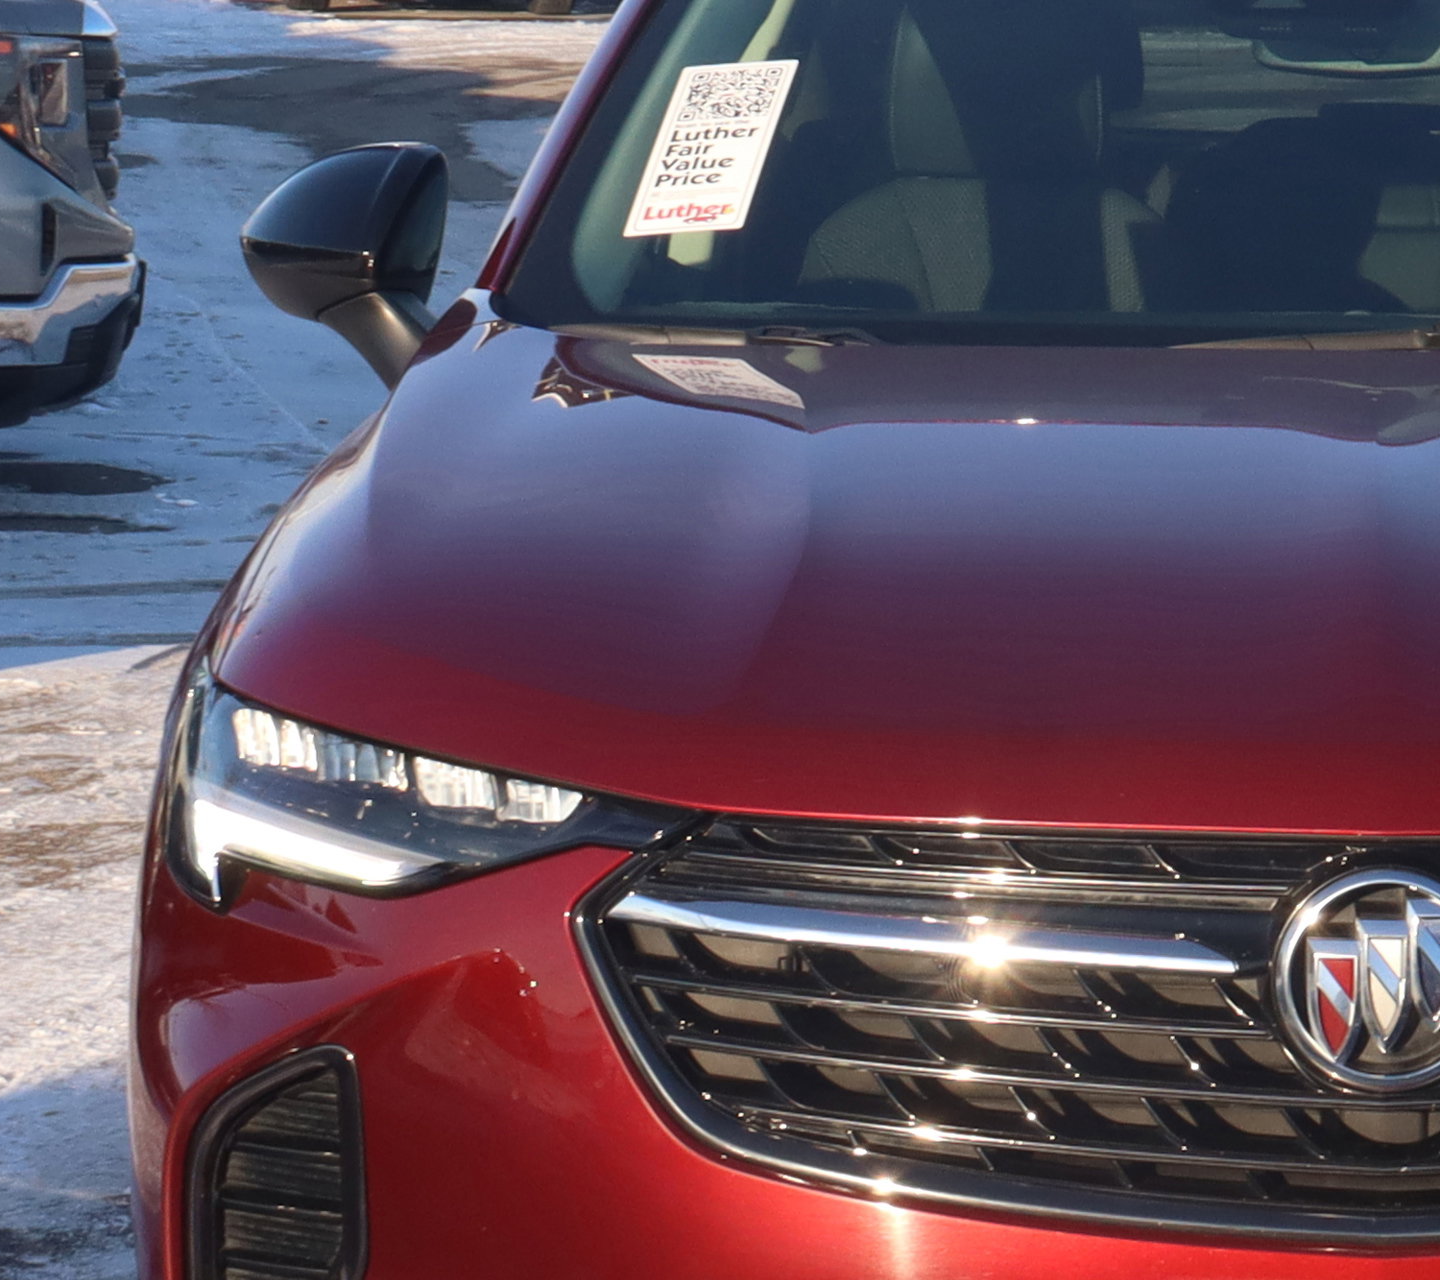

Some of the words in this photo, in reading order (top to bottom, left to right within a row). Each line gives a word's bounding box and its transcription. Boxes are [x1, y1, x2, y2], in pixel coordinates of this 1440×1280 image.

[671, 126, 760, 143] Luther
[665, 142, 715, 158] Fair
[662, 157, 735, 172] Value
[654, 171, 722, 187] Price
[643, 203, 732, 221] Luther
